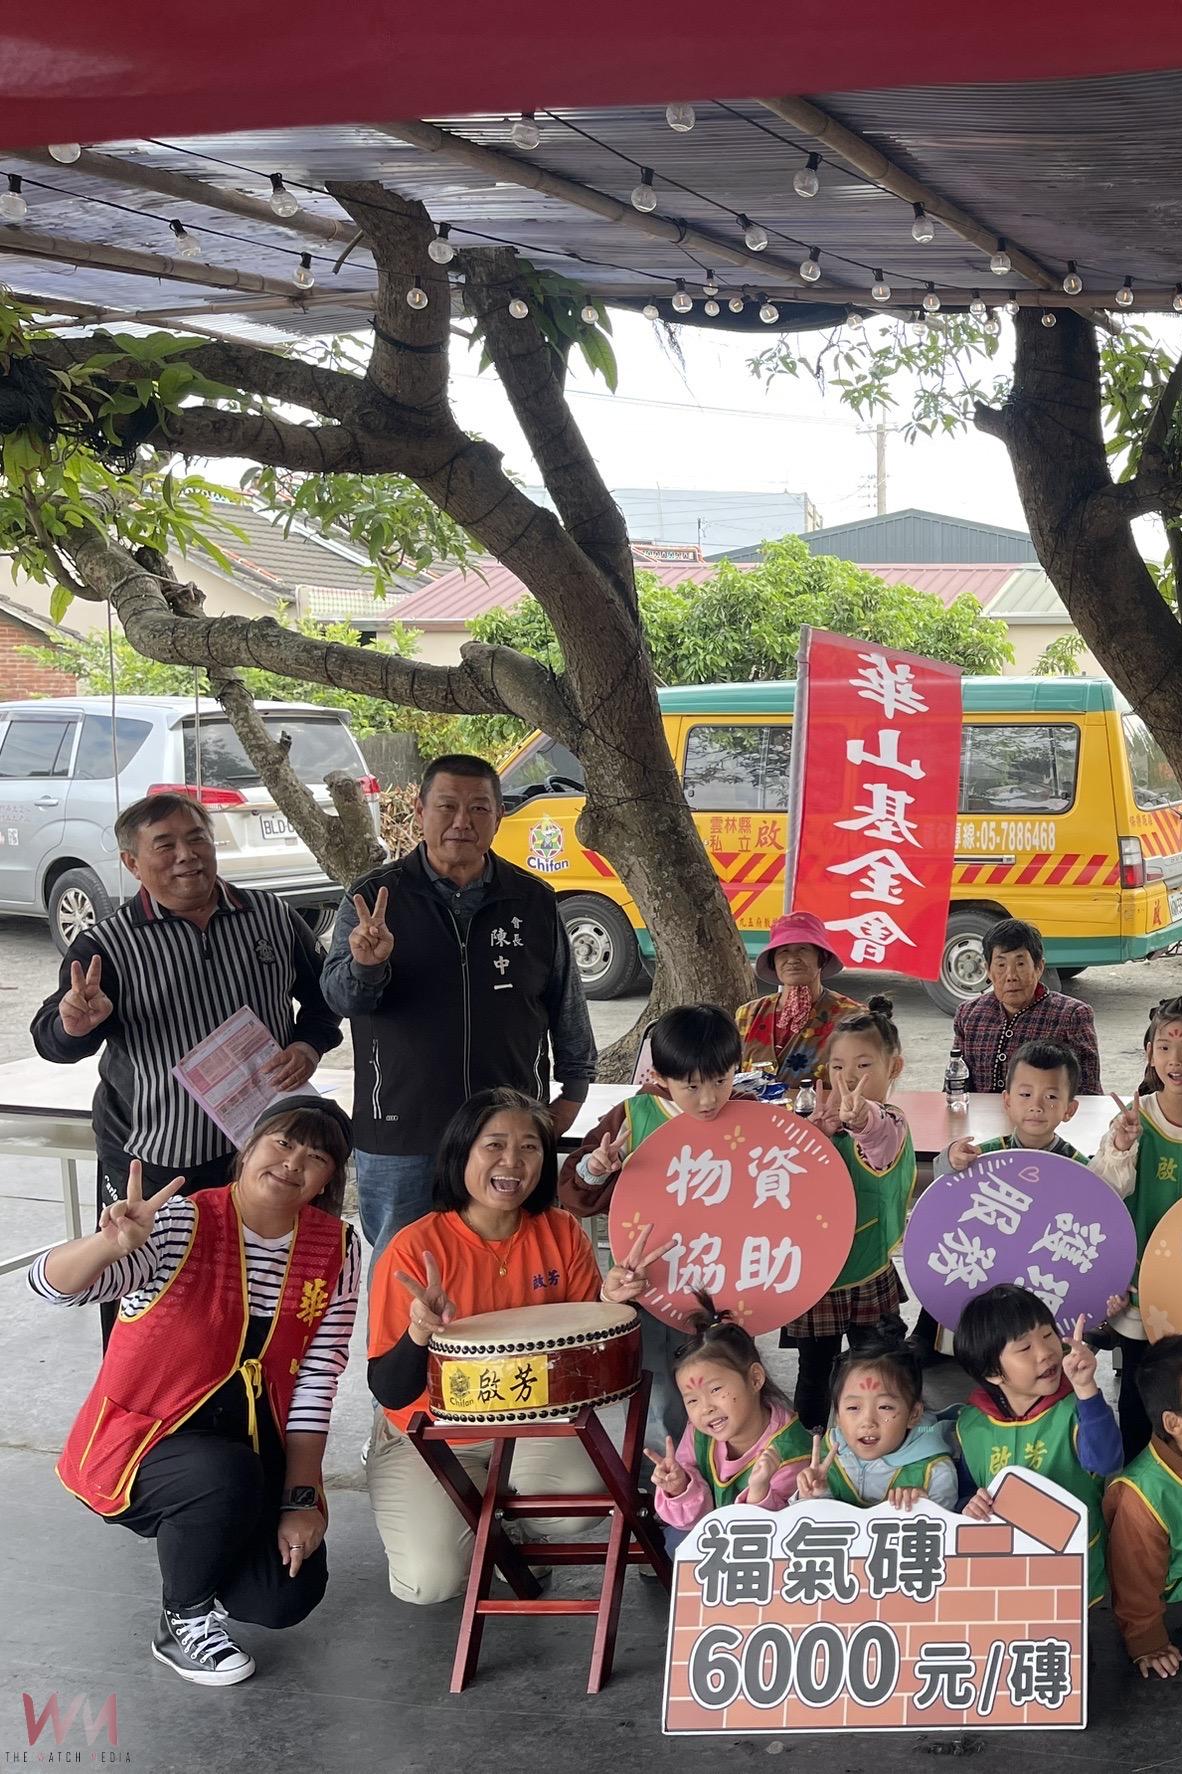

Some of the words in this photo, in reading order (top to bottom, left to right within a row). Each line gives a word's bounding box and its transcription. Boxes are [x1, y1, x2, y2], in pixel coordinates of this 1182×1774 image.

[710, 834, 751, 852] 私立
[711, 817, 751, 833] 雲林縣
[755, 820, 784, 850] 啟
[527, 856, 569, 872] Chifan
[511, 917, 524, 946] 會長
[490, 928, 513, 990] 陳中一
[666, 1144, 808, 1210] 物資
[927, 1172, 1034, 1290] 服務
[662, 1234, 802, 1297] 協助
[477, 1362, 538, 1404] 啟芳
[697, 1517, 946, 1607] 福氣磚
